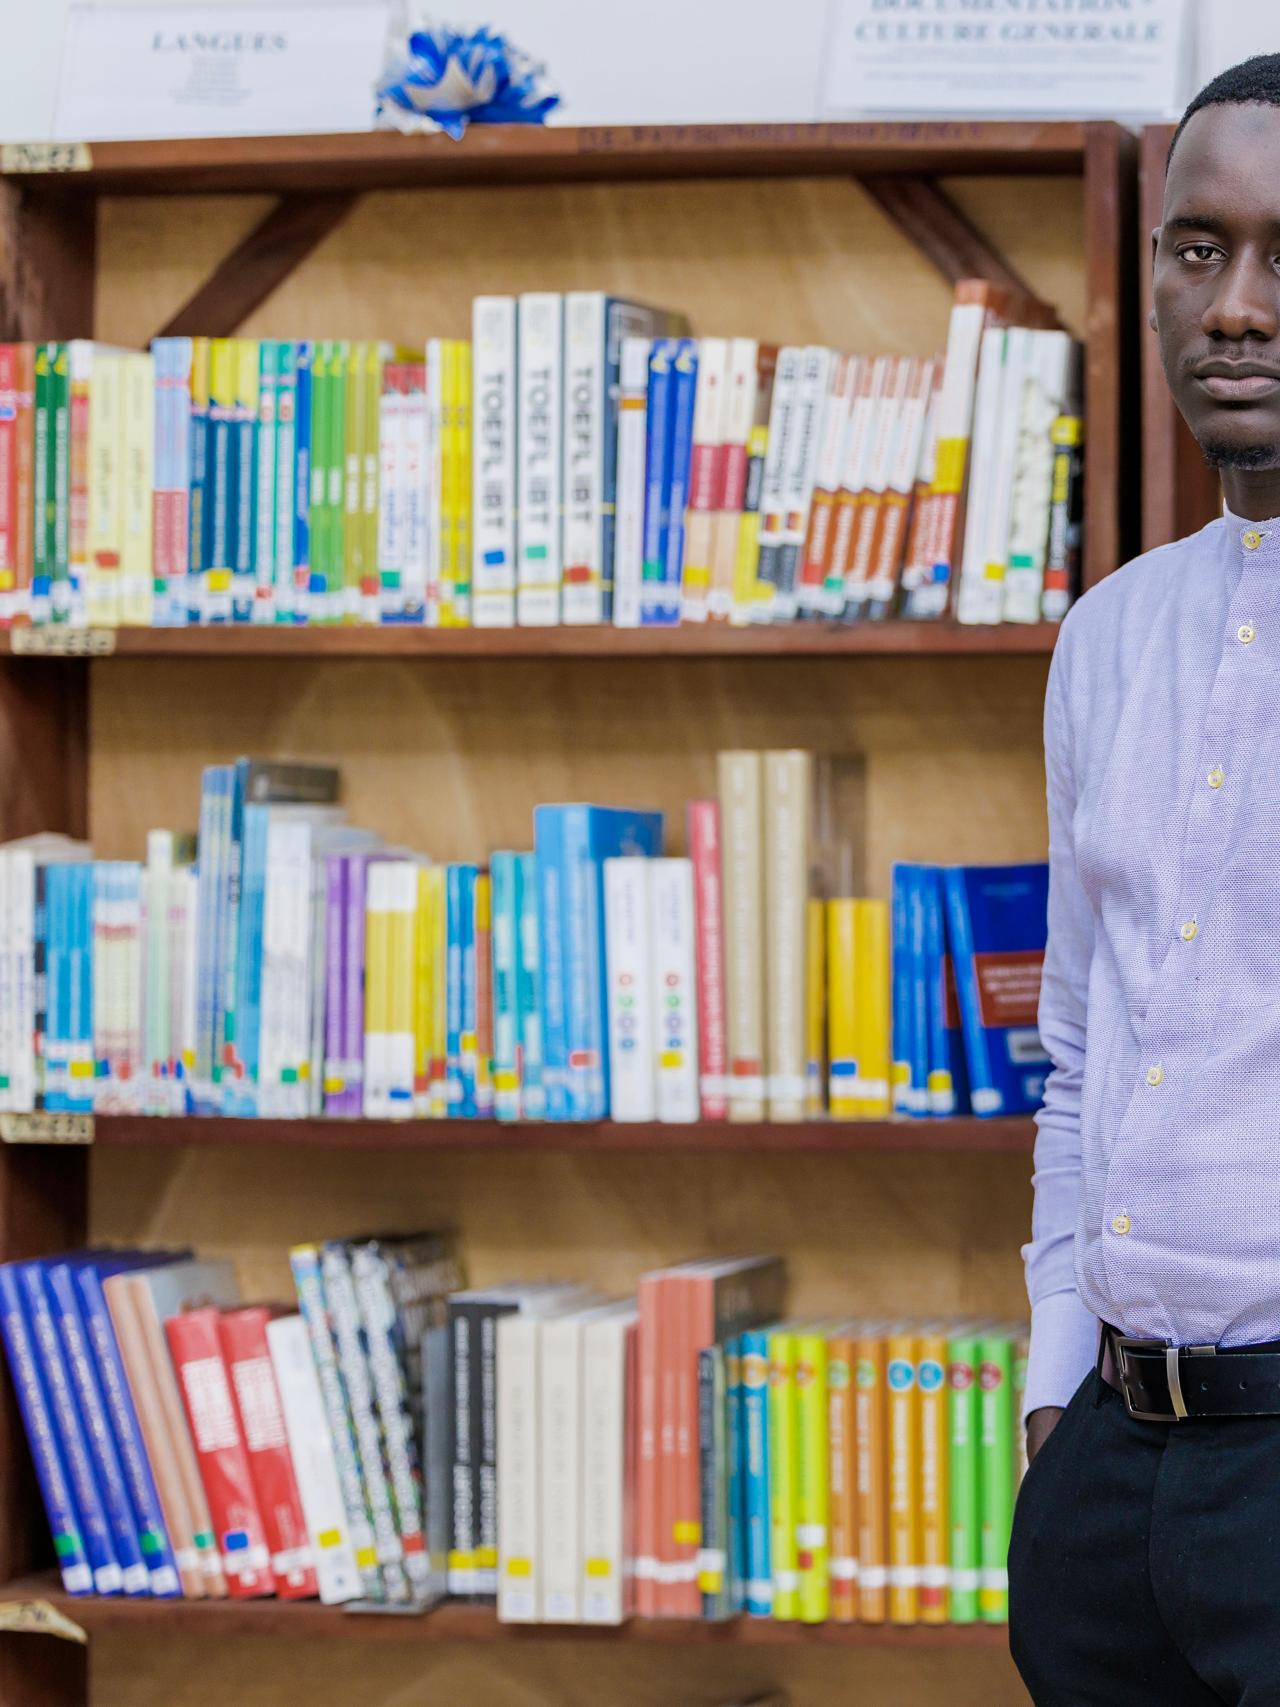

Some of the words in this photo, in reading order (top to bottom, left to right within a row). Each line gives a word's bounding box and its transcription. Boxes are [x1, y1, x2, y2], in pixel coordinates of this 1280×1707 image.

[151, 32, 288, 52] LANGUES
[855, 22, 987, 41] CULTURE
[1001, 22, 1160, 41] GENERALE
[482, 372, 507, 473] TOEFL
[528, 367, 550, 467] TOEFL
[572, 366, 594, 466] TOEFL
